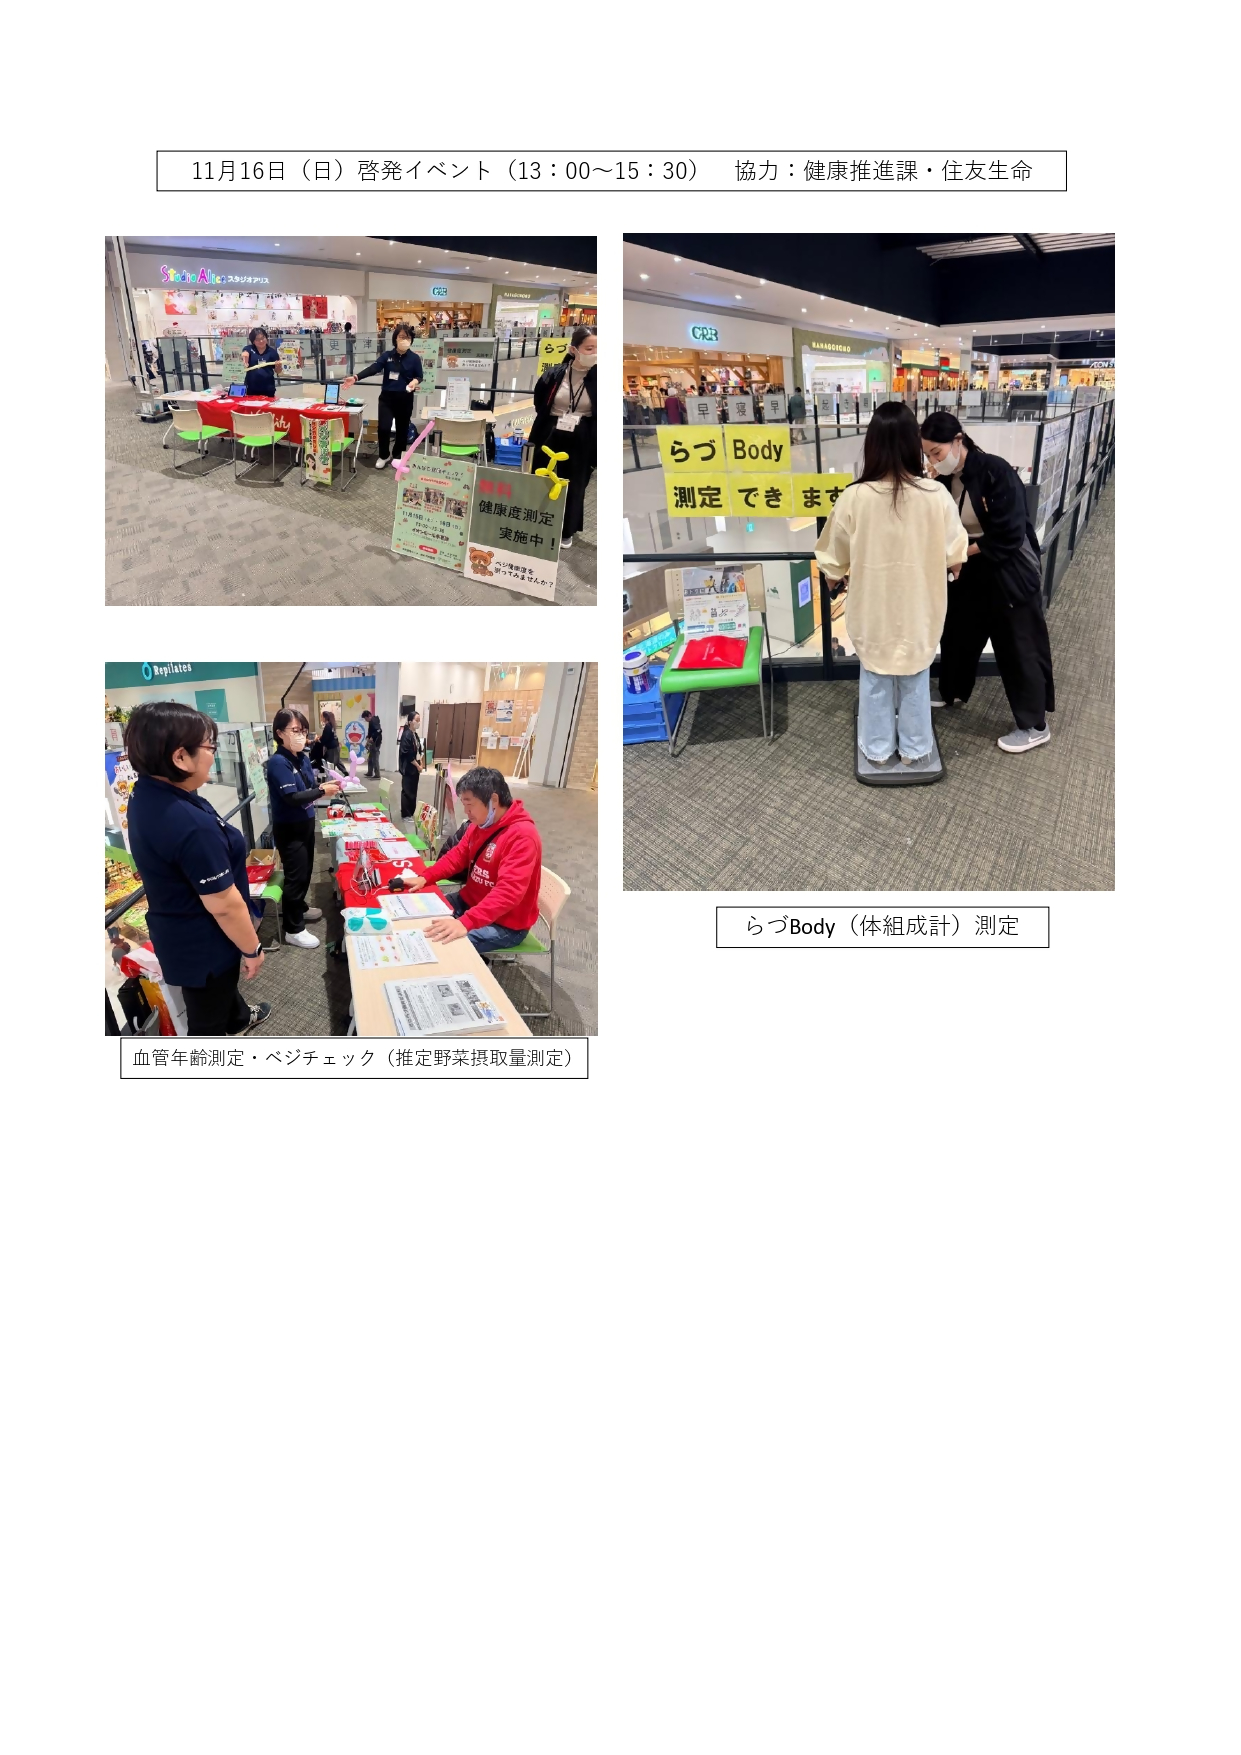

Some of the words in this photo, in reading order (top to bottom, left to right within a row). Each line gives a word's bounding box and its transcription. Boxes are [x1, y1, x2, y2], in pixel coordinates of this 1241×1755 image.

[160, 264, 197, 283] Studio
[197, 267, 227, 284] Alice
[227, 275, 270, 285] スタジオアリス
[670, 440, 716, 463] らづ
[733, 438, 784, 463] Body
[479, 499, 555, 527] 健康度測定
[499, 526, 556, 551] 実施中！
[153, 663, 193, 677] Repilates
